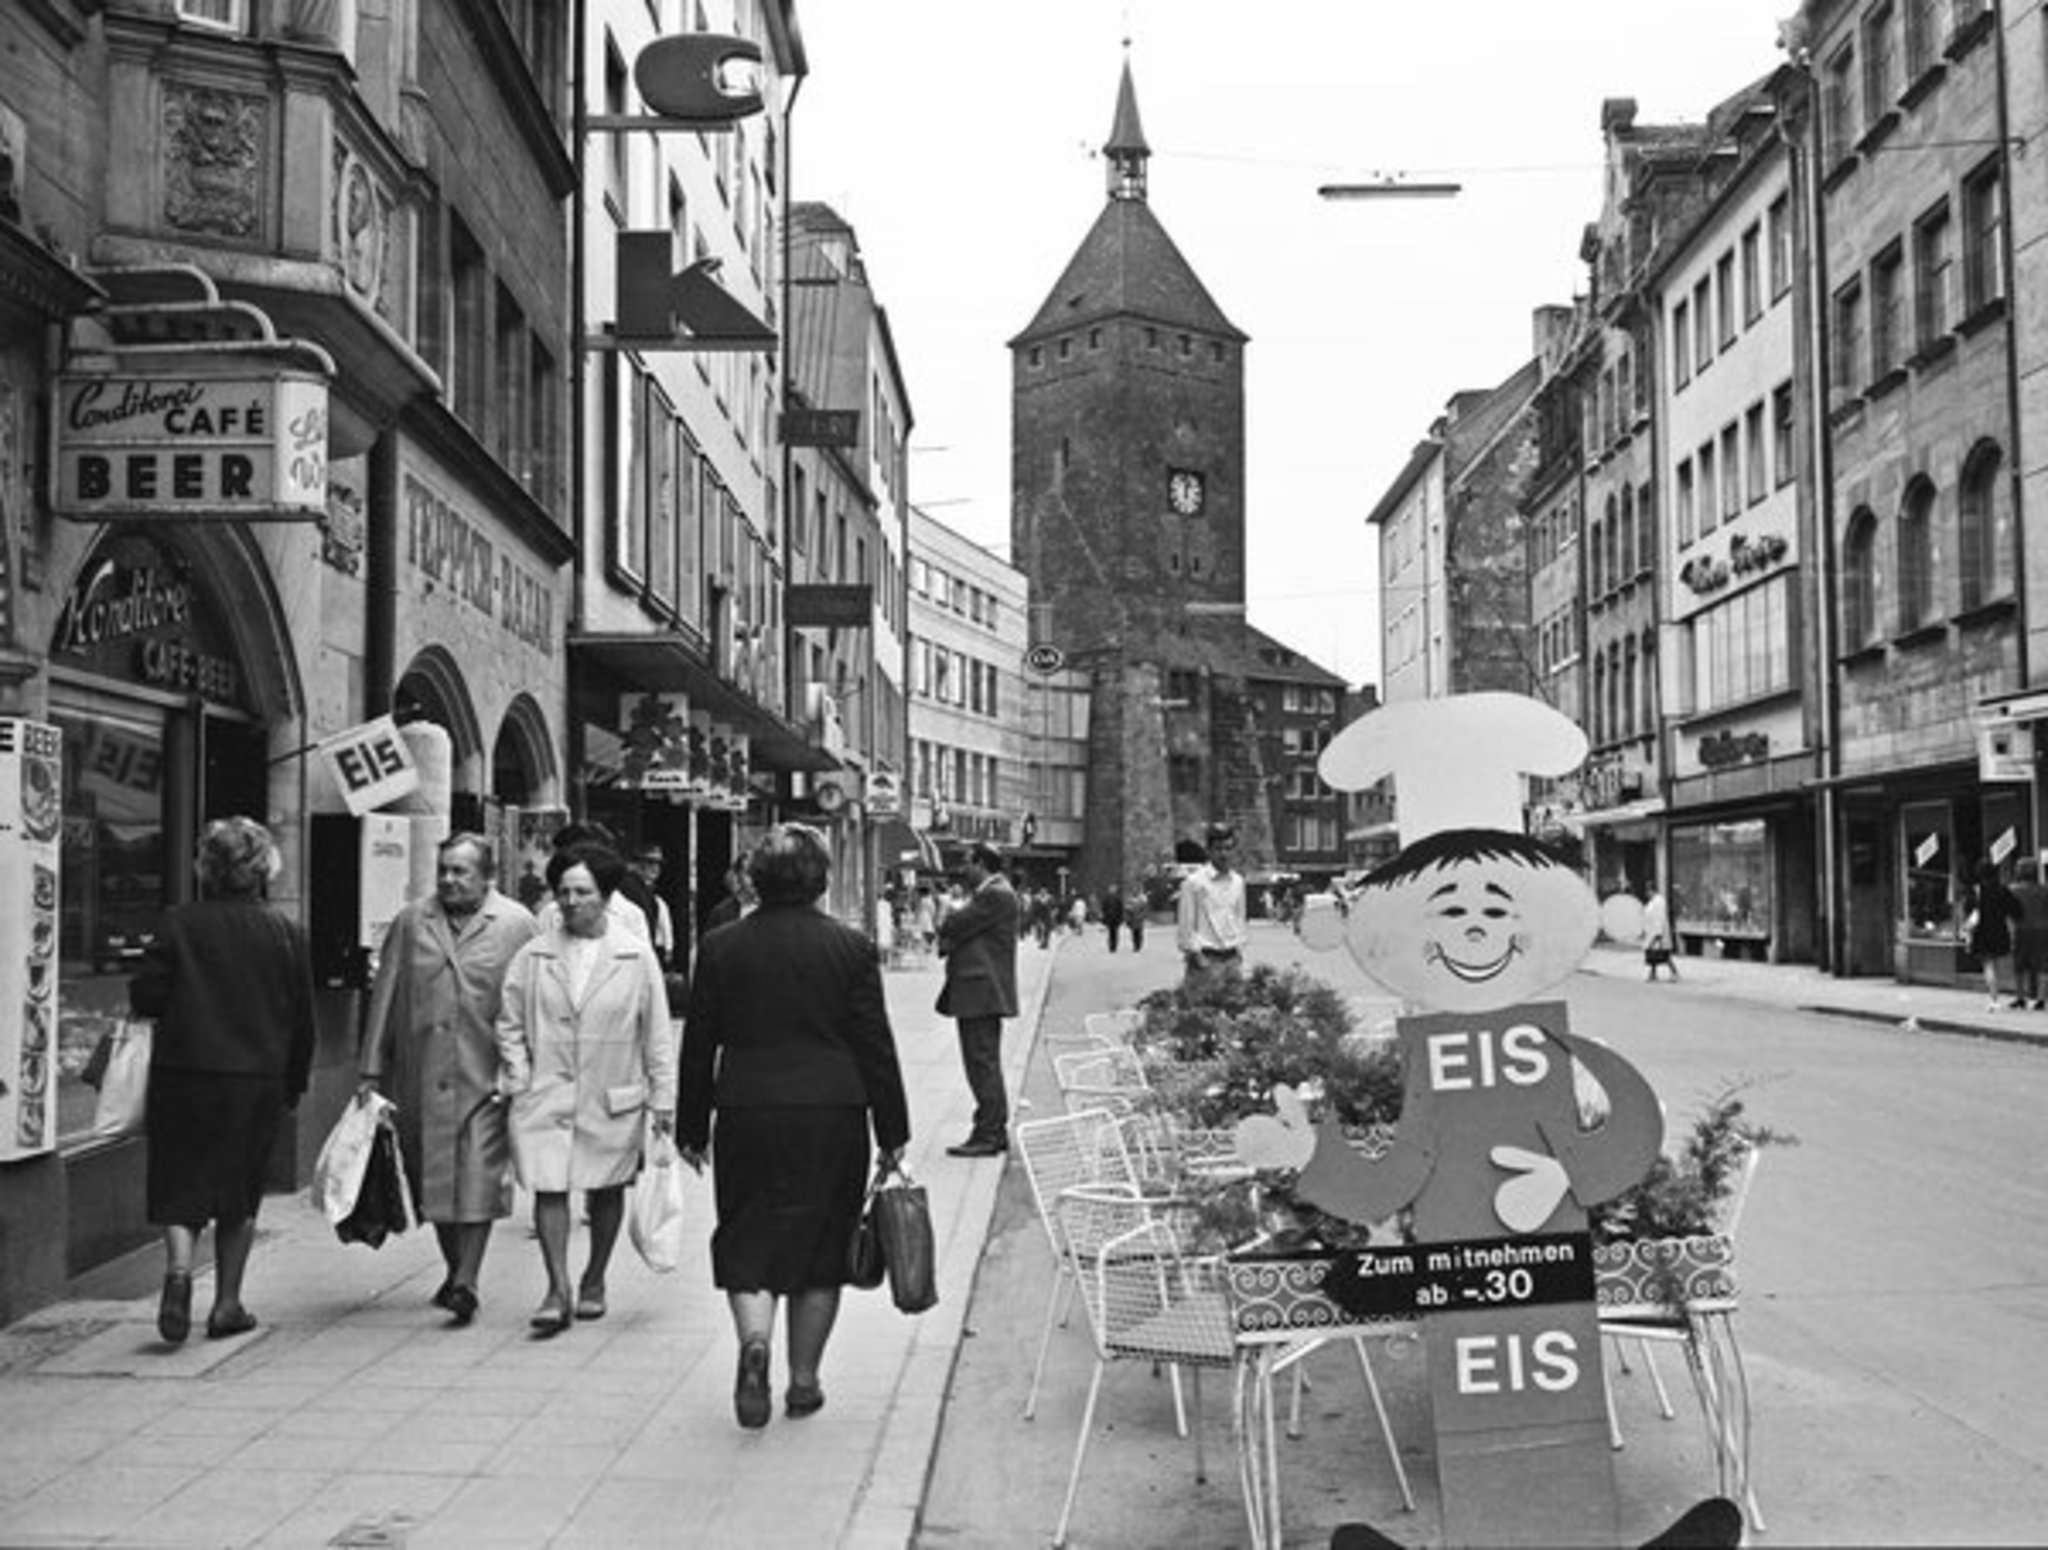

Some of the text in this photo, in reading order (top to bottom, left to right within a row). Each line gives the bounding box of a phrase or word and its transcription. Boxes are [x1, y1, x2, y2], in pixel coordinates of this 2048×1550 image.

[163, 402, 264, 436] CAFÉ
[77, 454, 254, 500] BEER
[334, 738, 406, 792] EIS
[1427, 1024, 1550, 1091] EIS
[1356, 1242, 1574, 1278] Zum mitnehmen
[1415, 1283, 1449, 1306] ab
[1455, 1331, 1580, 1395] EIS
